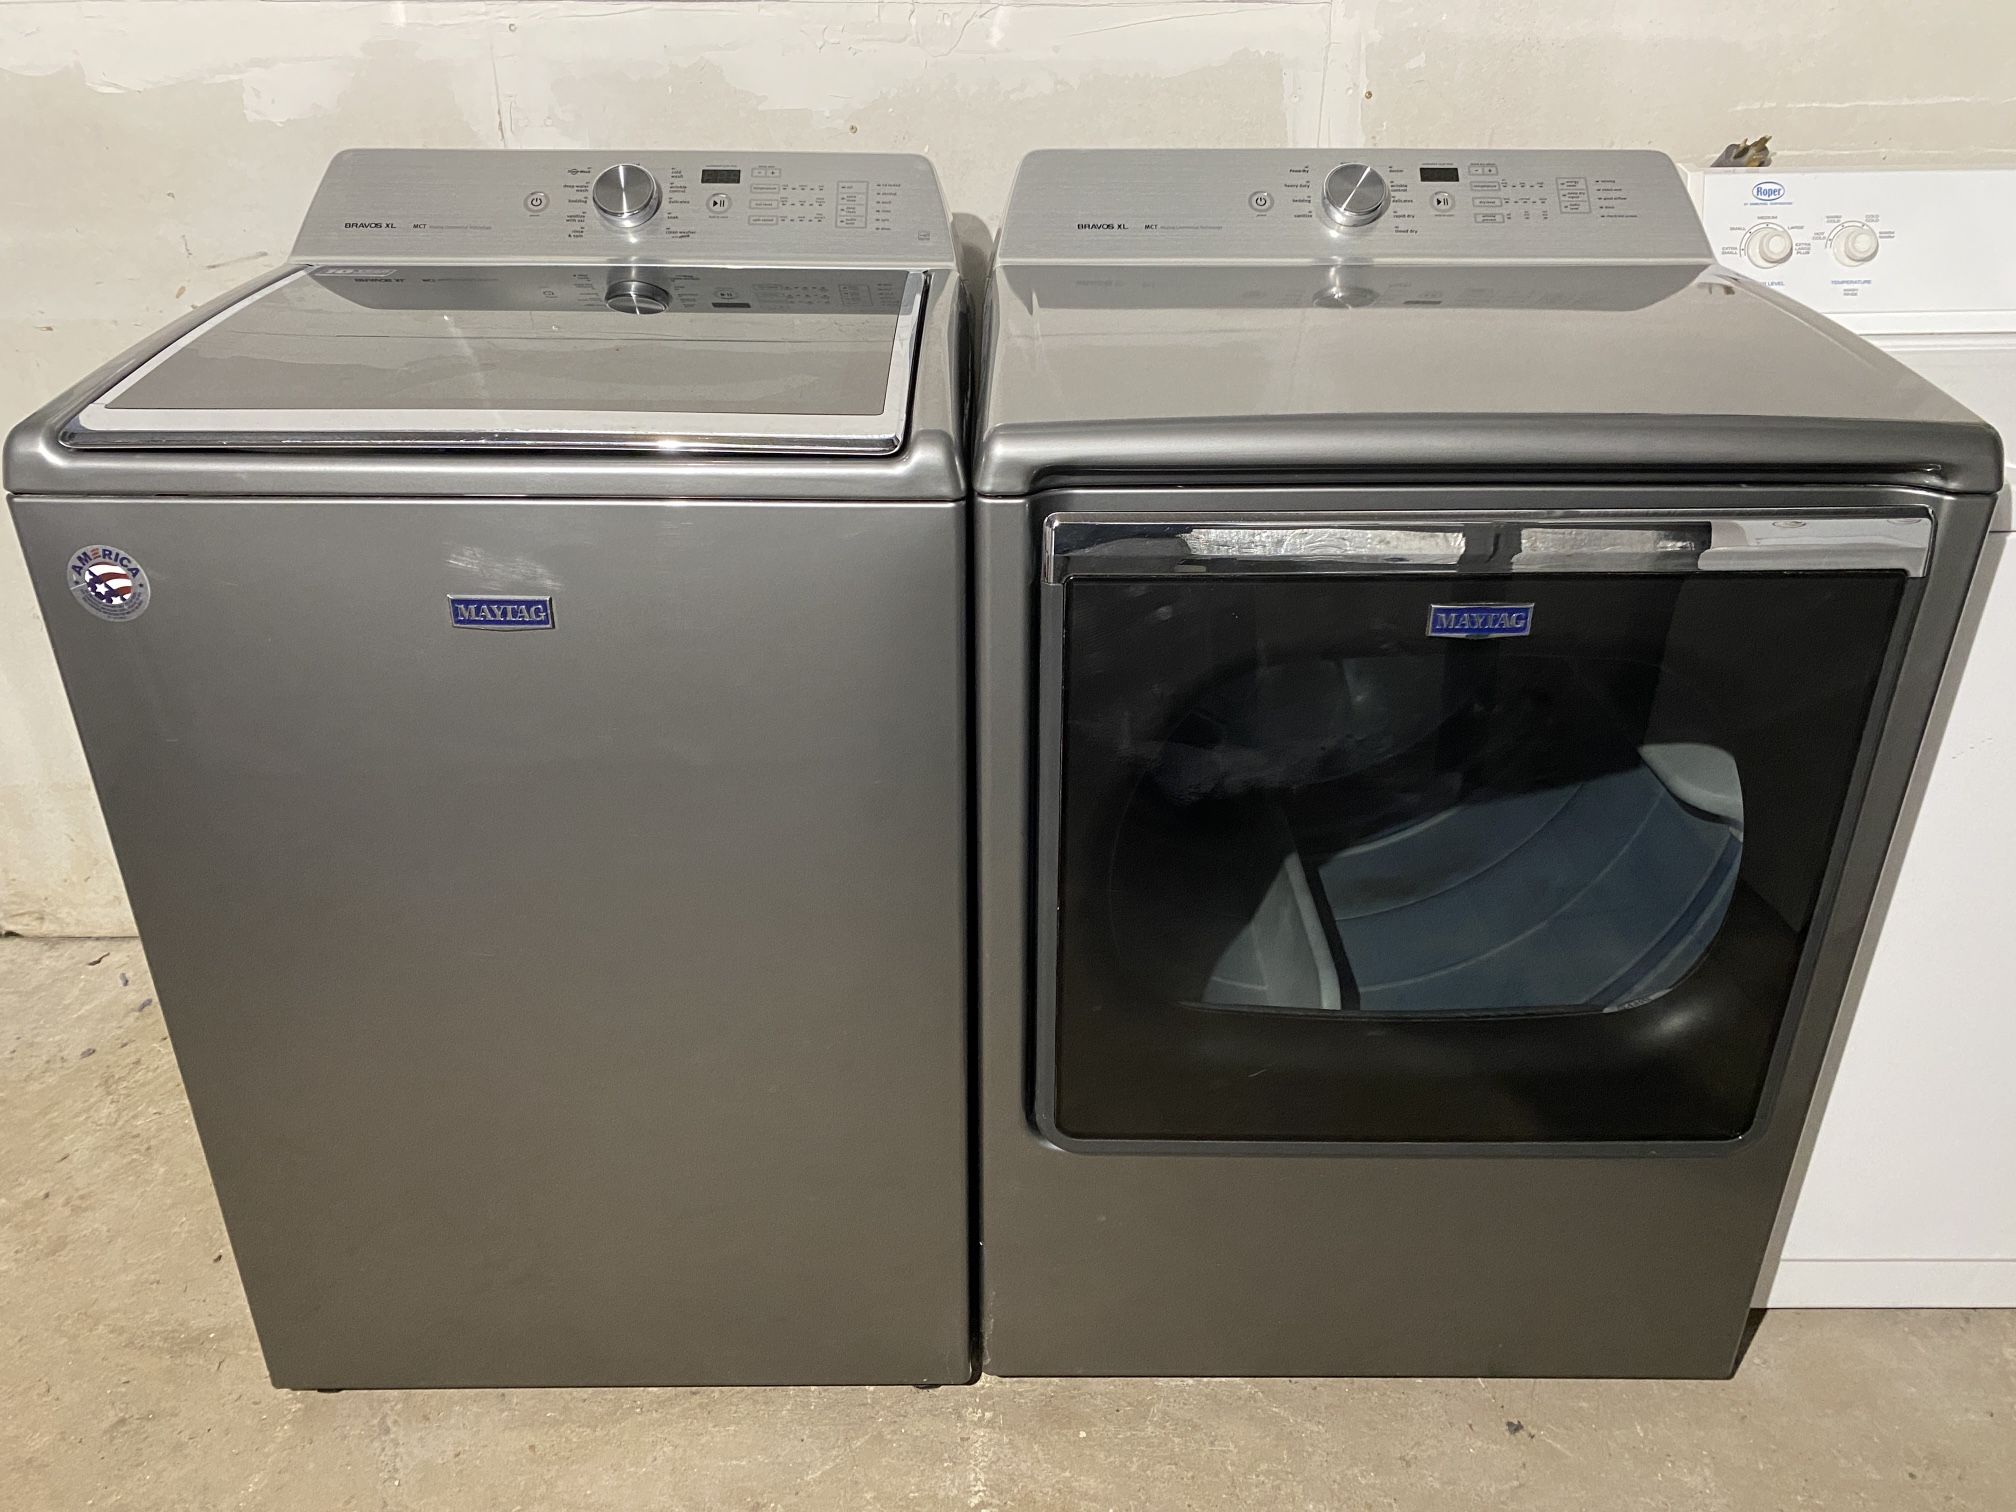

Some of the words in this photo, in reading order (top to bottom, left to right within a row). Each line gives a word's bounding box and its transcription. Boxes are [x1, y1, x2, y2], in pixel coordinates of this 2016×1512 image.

[1756, 186, 1782, 198] Roper
[71, 547, 140, 578] AMERICA
[455, 605, 546, 621] MAYTAG
[1436, 613, 1526, 629] MAYTAG
